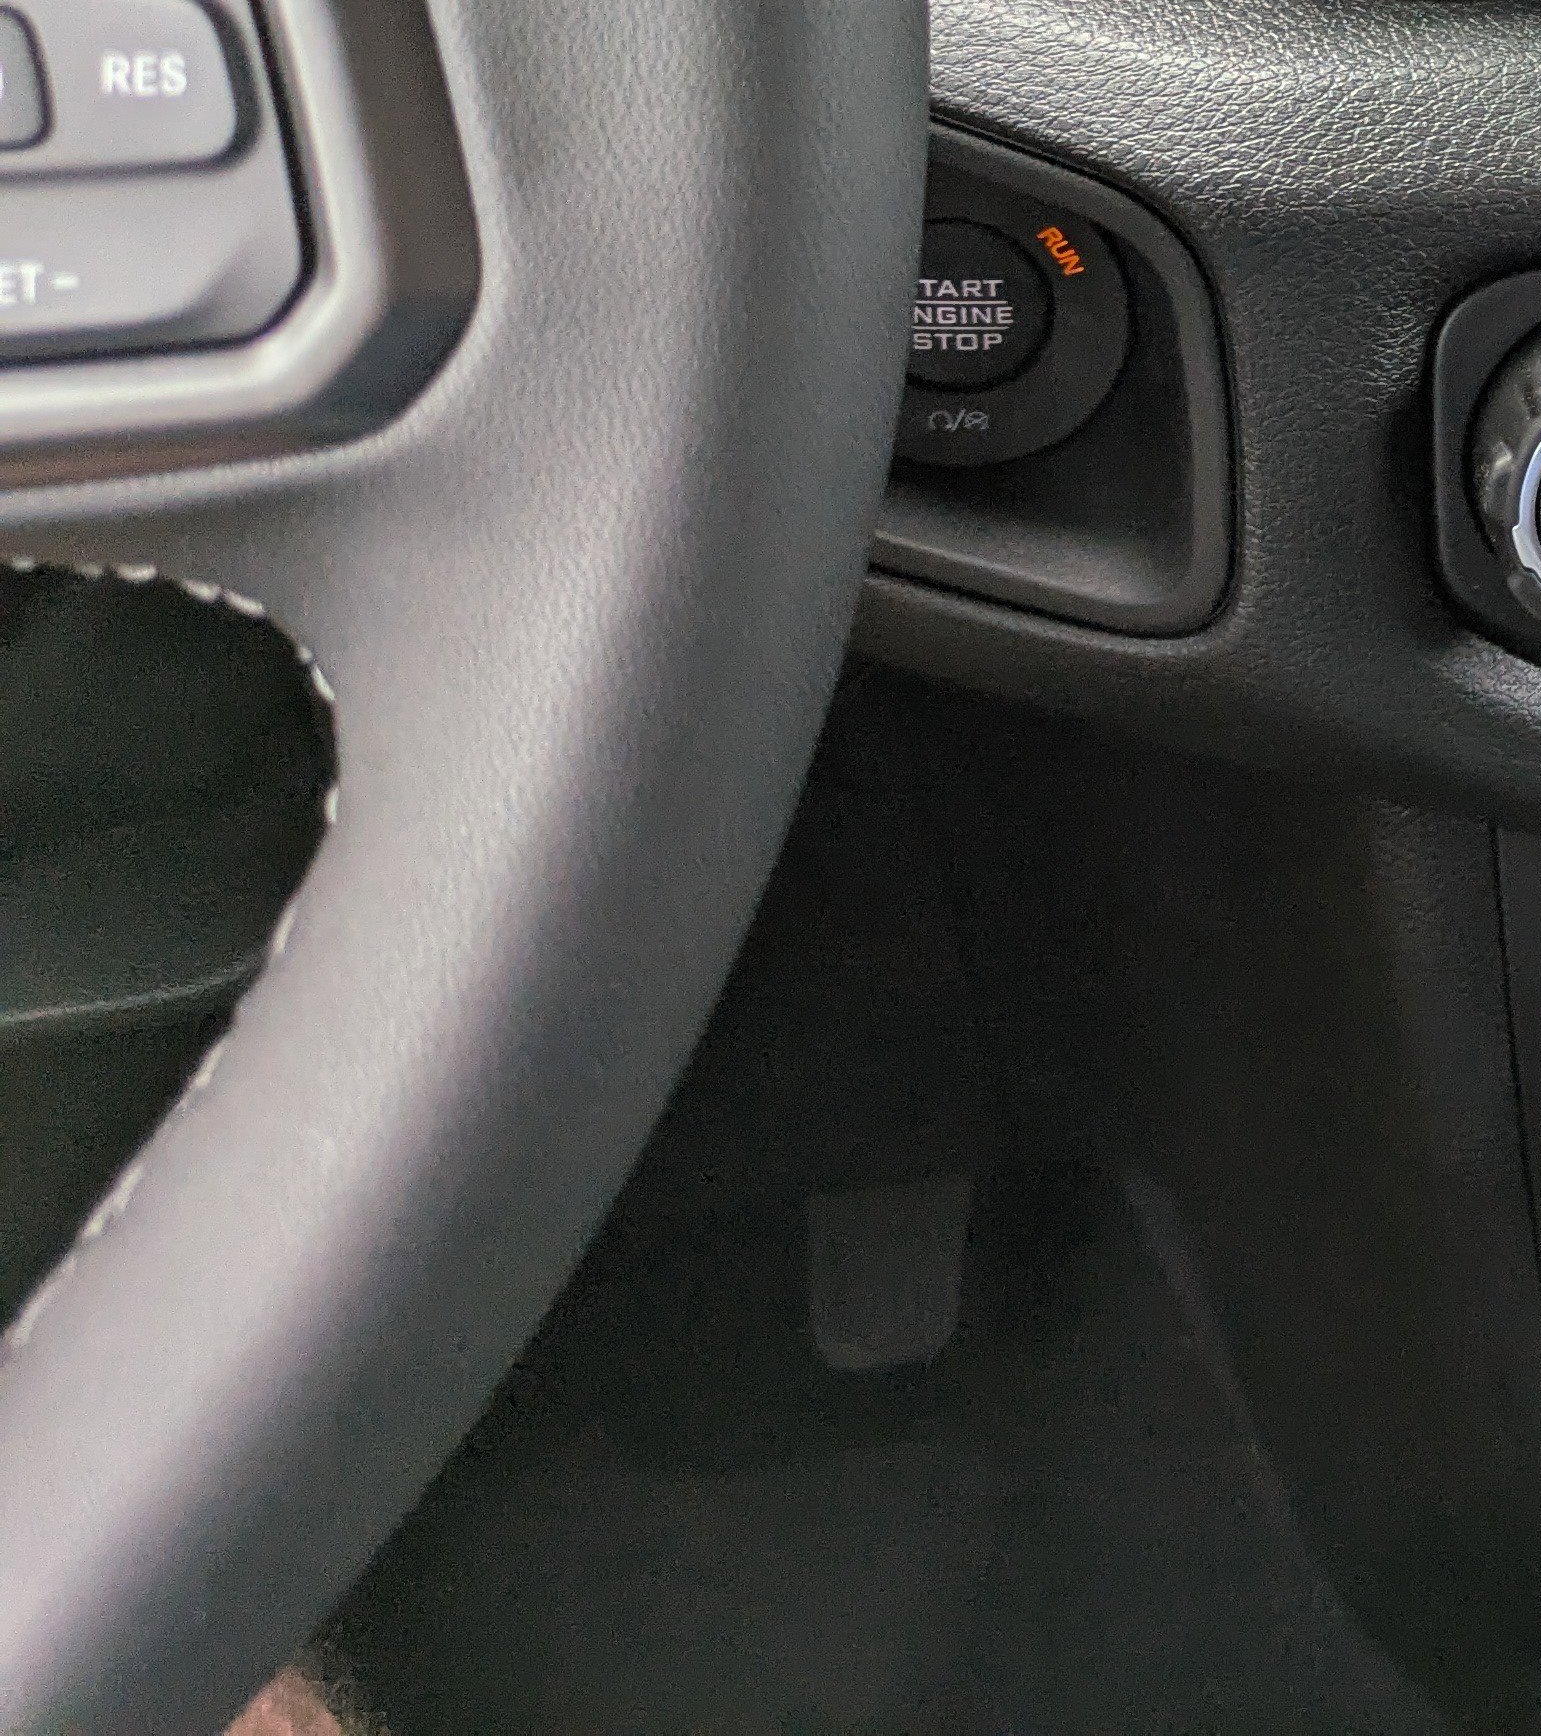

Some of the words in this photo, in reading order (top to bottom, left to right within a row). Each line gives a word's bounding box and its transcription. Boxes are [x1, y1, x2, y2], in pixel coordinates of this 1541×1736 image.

[101, 50, 188, 97] RES
[1036, 226, 1086, 278] RUN
[918, 278, 1005, 298] TART
[912, 306, 1015, 325] NGINE
[912, 332, 1003, 352] STOP
